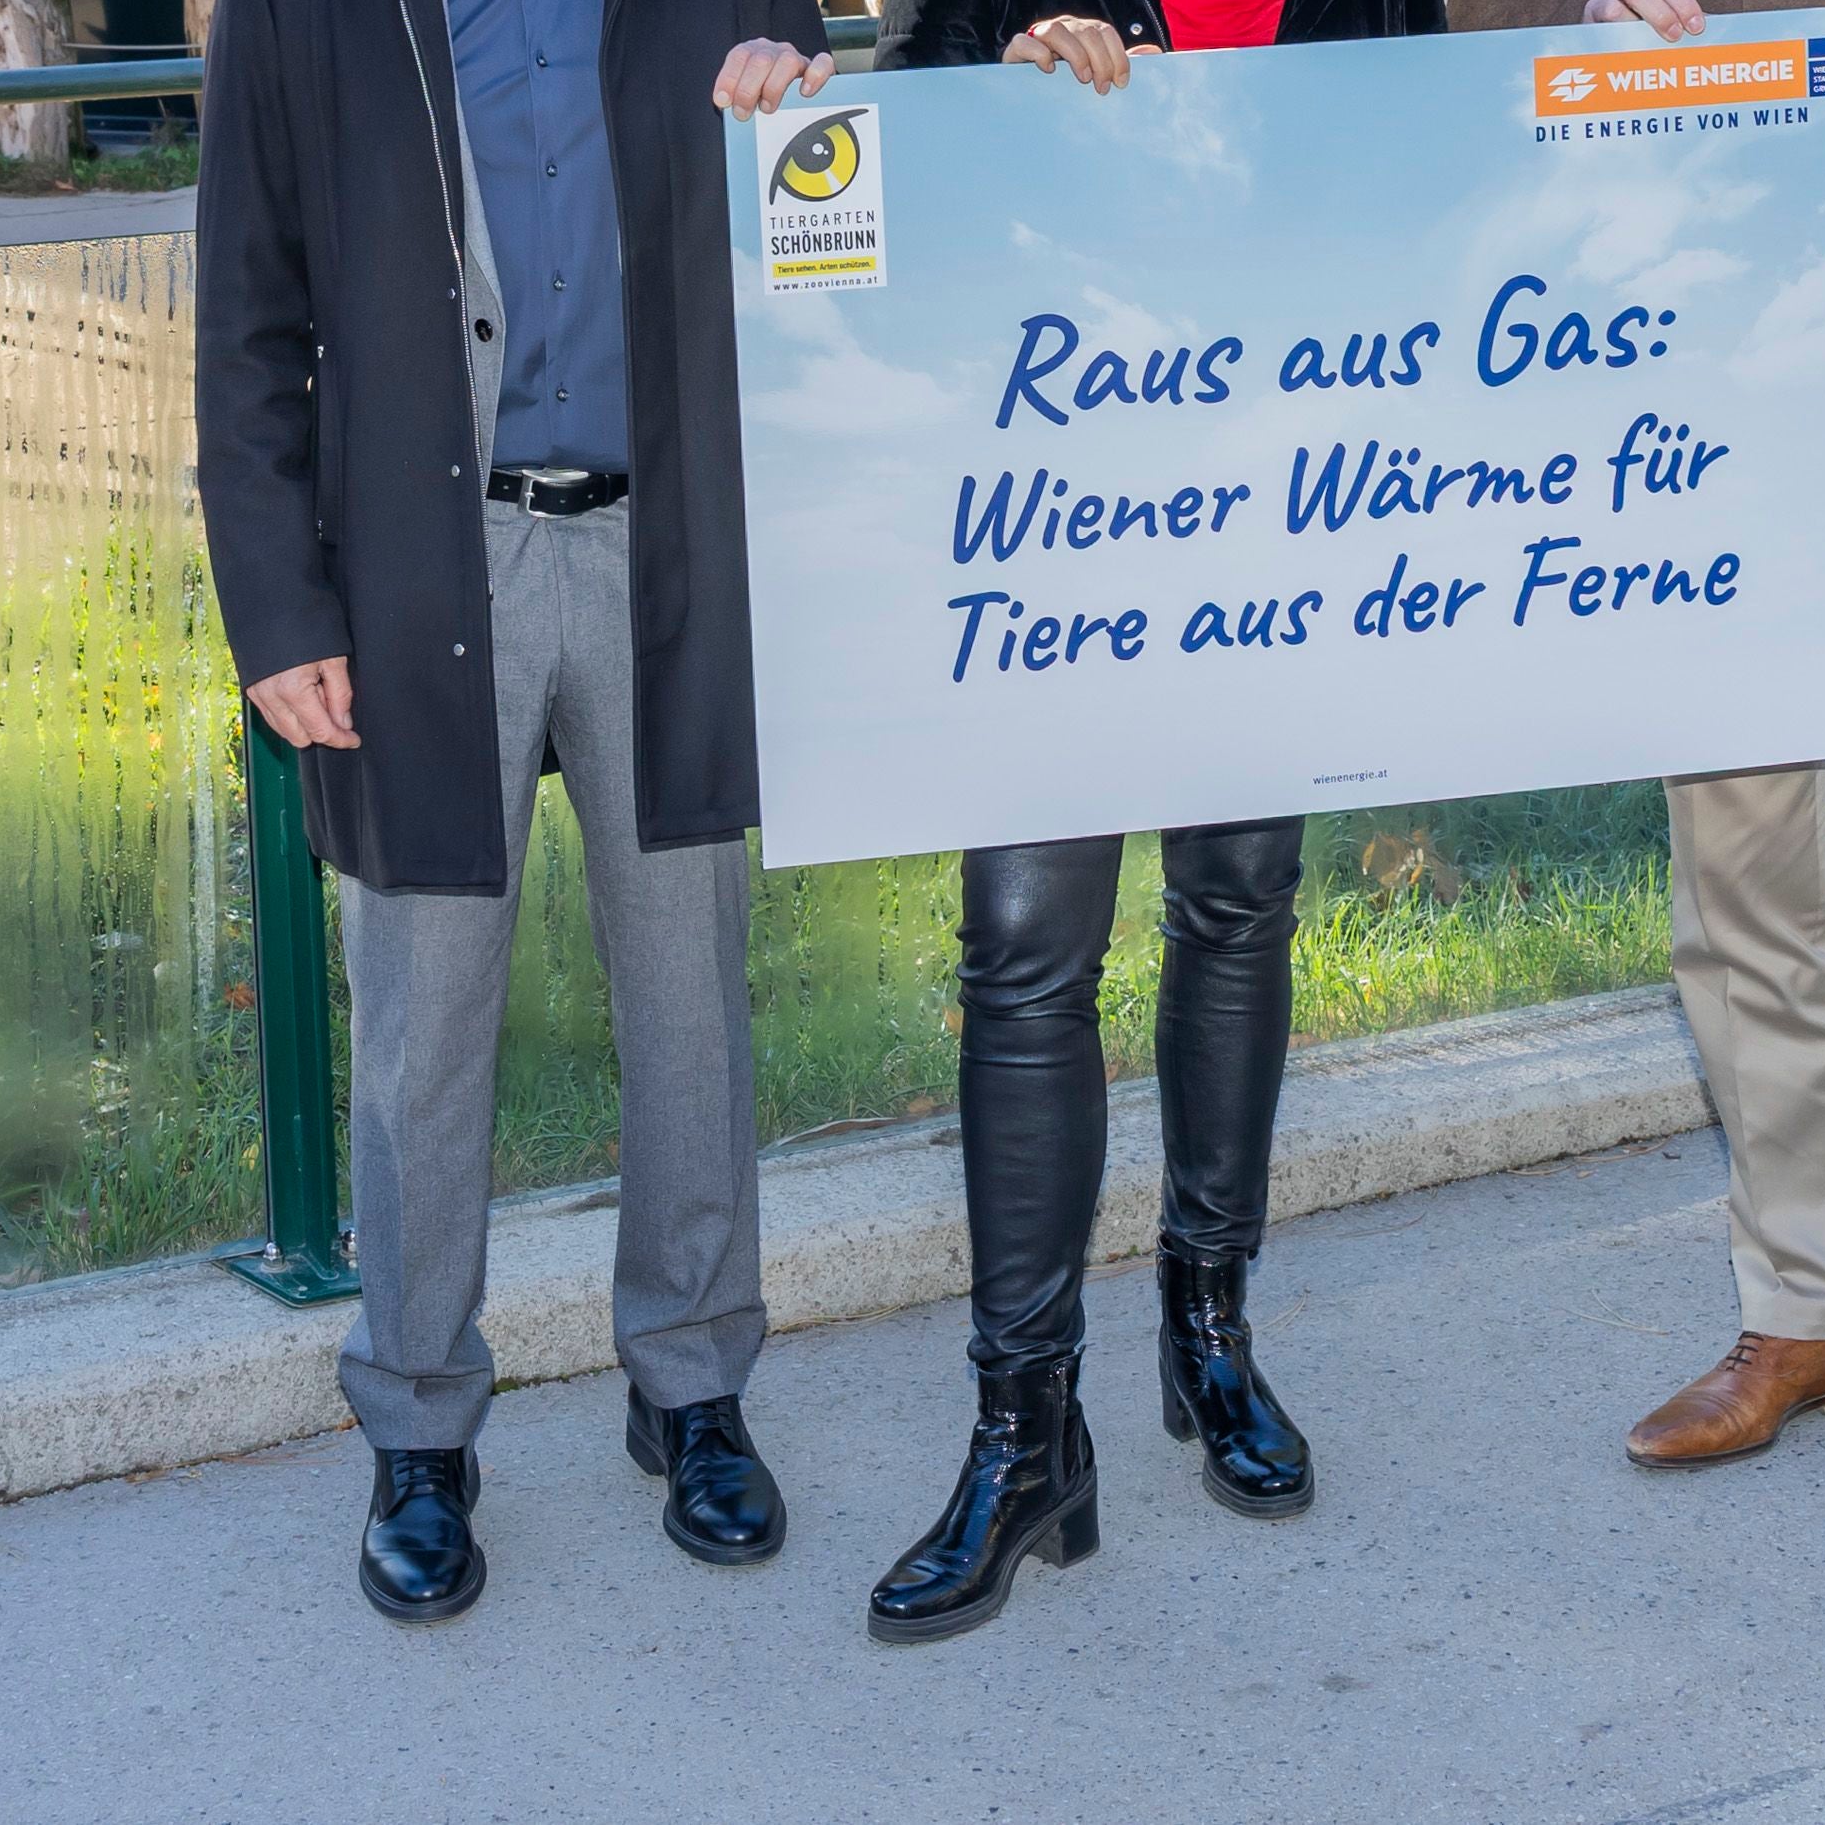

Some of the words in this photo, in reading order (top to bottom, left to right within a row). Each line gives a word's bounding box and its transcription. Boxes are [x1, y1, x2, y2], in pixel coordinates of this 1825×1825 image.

[1606, 66, 1678, 93] WIEN
[1684, 59, 1795, 88] ENERGIE
[1535, 124, 1571, 143] DIE
[1585, 116, 1684, 139] ENERGIE
[1697, 112, 1739, 131] VON
[1753, 106, 1810, 126] WIEN
[770, 210, 875, 230] TIERGARTEN
[771, 230, 876, 255] SCHÖNBRUNN
[777, 266, 795, 274] Tiere
[795, 265, 818, 273] sehen.
[819, 263, 838, 271] Arten
[839, 260, 871, 270] schützen.
[774, 277, 877, 290] www.zoovienna.at
[995, 313, 1244, 430] Raus
[1278, 321, 1441, 394] aus
[1477, 274, 1677, 388] Gas:
[953, 468, 1251, 565] Wiener
[1286, 439, 1578, 535] Wärme
[1606, 412, 1730, 514] für
[947, 591, 1148, 683] Tiere
[1179, 581, 1324, 654] aus
[1353, 552, 1487, 638] der
[1513, 535, 1741, 627] Ferne
[1312, 769, 1388, 785] wienenergie.at
